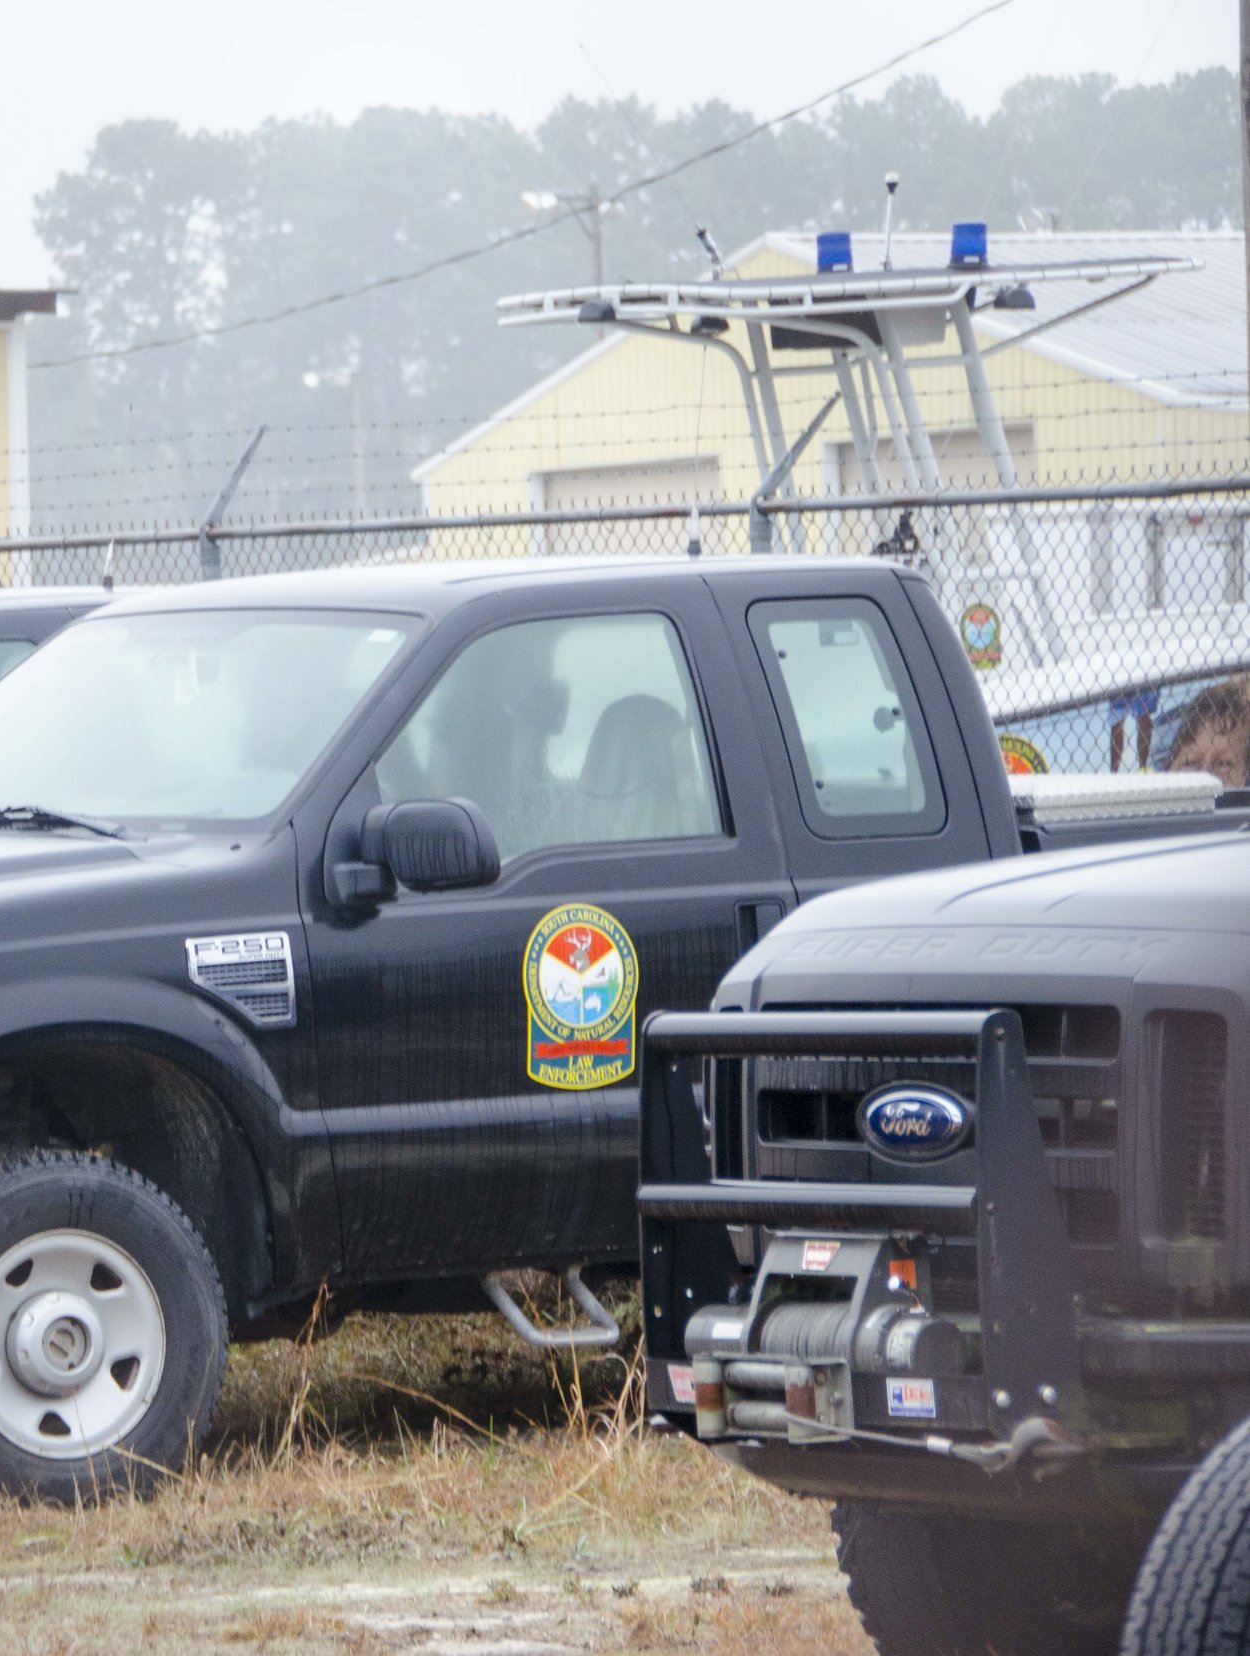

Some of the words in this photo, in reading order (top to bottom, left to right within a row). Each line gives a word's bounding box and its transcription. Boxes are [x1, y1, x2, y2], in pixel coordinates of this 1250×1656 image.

[541, 910, 569, 937] SOUTH
[570, 908, 616, 935] CAROLINA
[193, 937, 285, 956] F-250
[784, 933, 956, 959] SUPER
[977, 933, 1171, 961] DUTY
[574, 1018, 616, 1041] NATURAL
[538, 1060, 623, 1085] ENFORCEMENT
[568, 1054, 594, 1071] LAW
[881, 1102, 932, 1137] Ford
